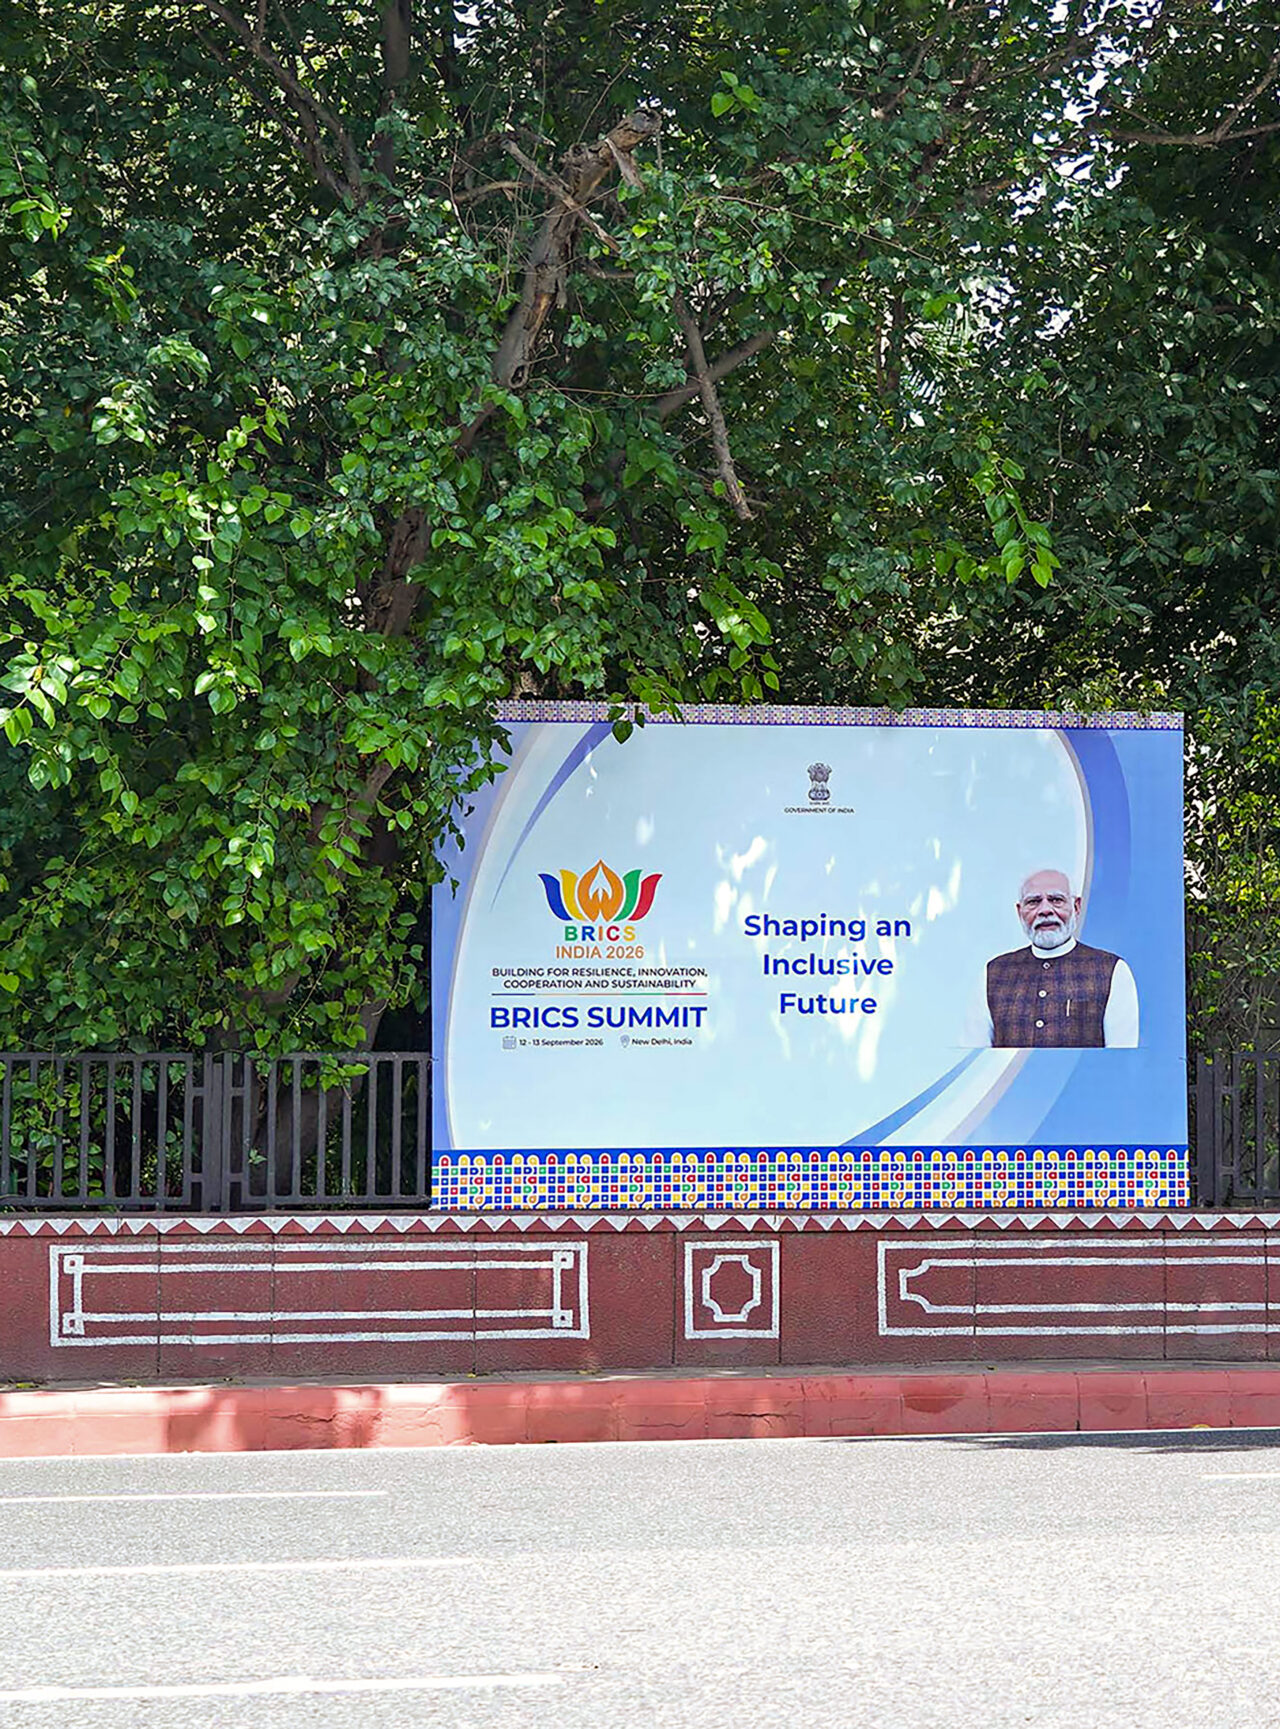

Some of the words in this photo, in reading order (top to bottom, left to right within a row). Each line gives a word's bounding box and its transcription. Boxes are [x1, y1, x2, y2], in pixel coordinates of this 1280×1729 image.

[564, 925, 636, 942] BRICS
[744, 913, 866, 942] Shaping
[876, 920, 911, 937] an
[556, 945, 602, 959] INDIA
[606, 945, 645, 959] 2026
[763, 952, 894, 975] Inclusive
[492, 967, 545, 977] BUILDING
[547, 967, 569, 977] FOR
[571, 967, 636, 978] RESILIENCE,
[638, 967, 708, 978] INNOVATION,
[503, 979, 582, 989] COOPERATION
[584, 979, 609, 989] AND
[611, 979, 696, 989] SUSTAINABILITY
[780, 993, 877, 1014] Future
[490, 1006, 579, 1028] BRICS
[587, 1006, 708, 1028] SUMMIT
[541, 1038, 584, 1048] September
[584, 1038, 604, 1046] 2026
[631, 1038, 650, 1046] New
[651, 1038, 673, 1046] Delhi,
[674, 1038, 692, 1046] India
